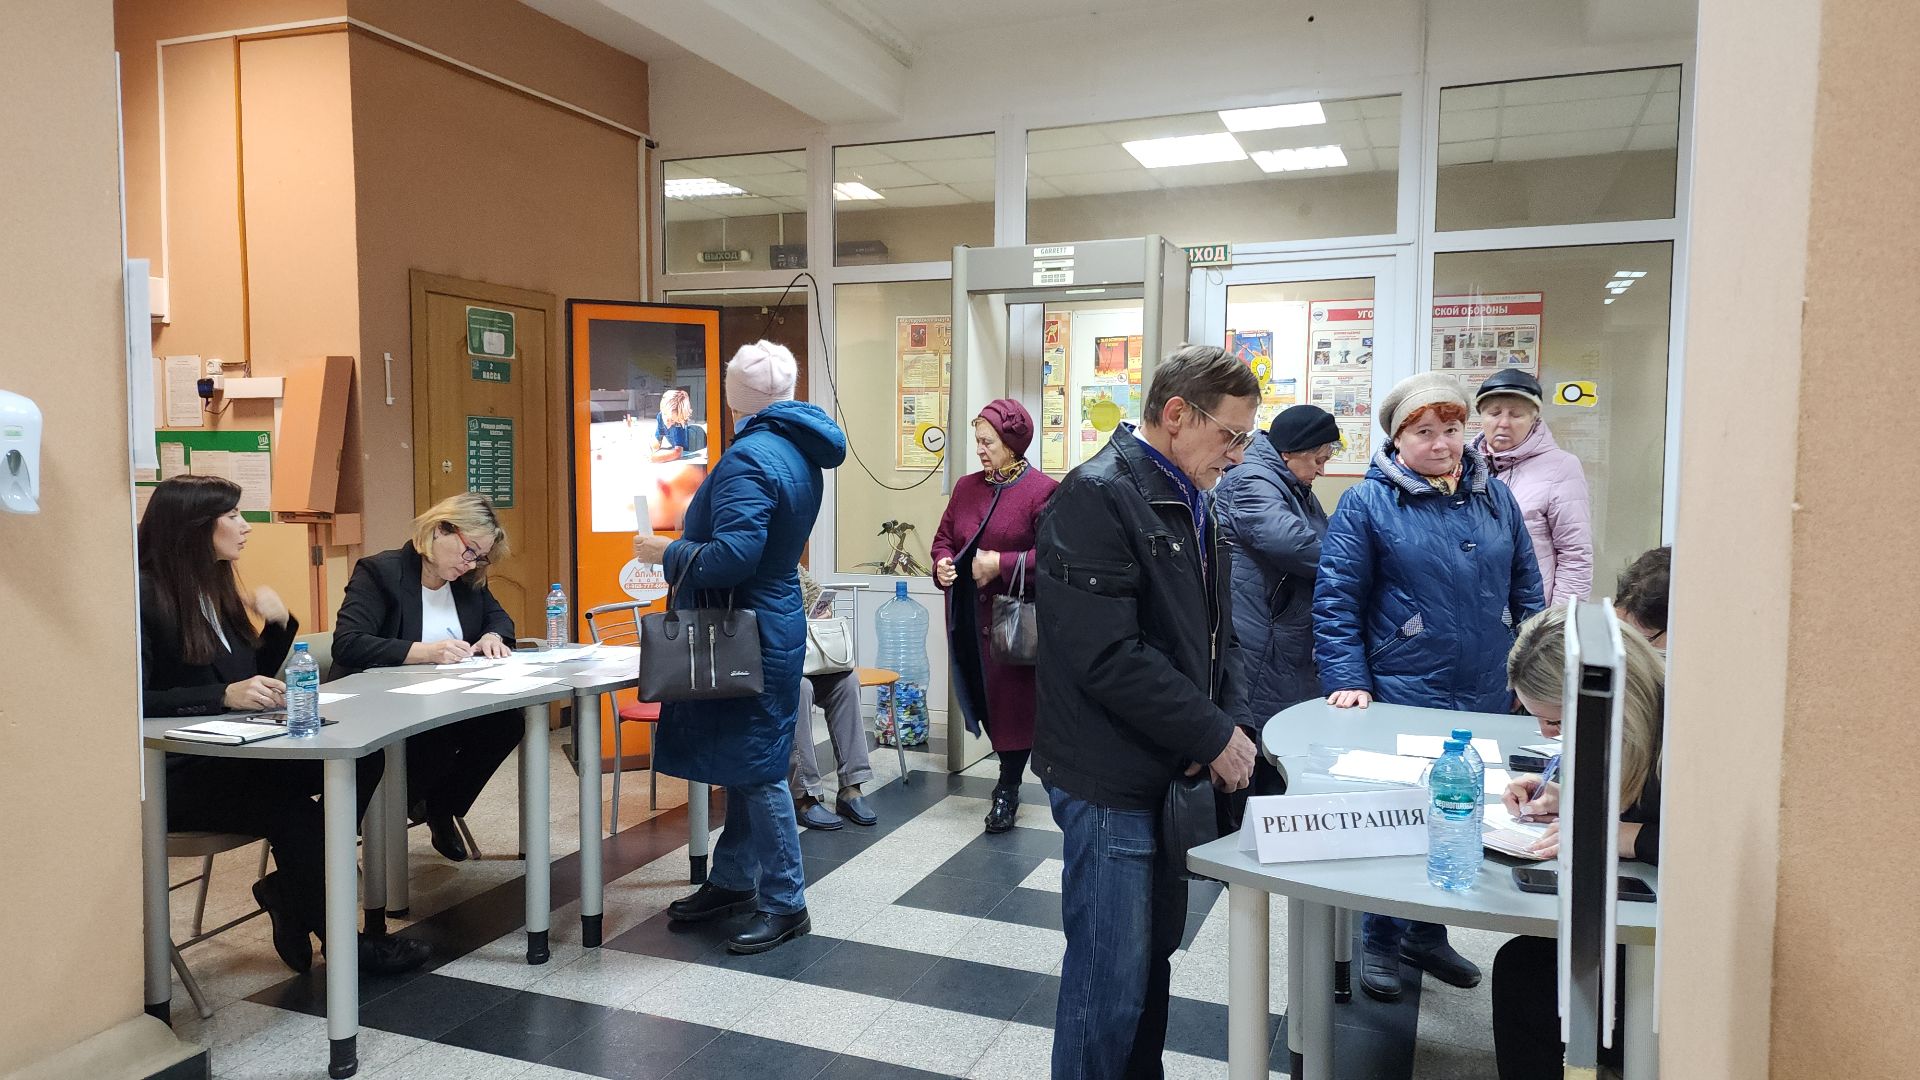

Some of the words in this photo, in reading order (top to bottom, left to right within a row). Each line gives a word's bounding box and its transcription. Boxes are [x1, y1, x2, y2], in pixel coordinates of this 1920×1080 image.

[704, 251, 738, 261] ВЫХОД
[1040, 247, 1067, 255] GARRETT
[1461, 305, 1508, 316] ОБОРОНЫ
[482, 371, 501, 381] КАССА
[1262, 808, 1426, 833] РЕГИСТРАЦИЯ
